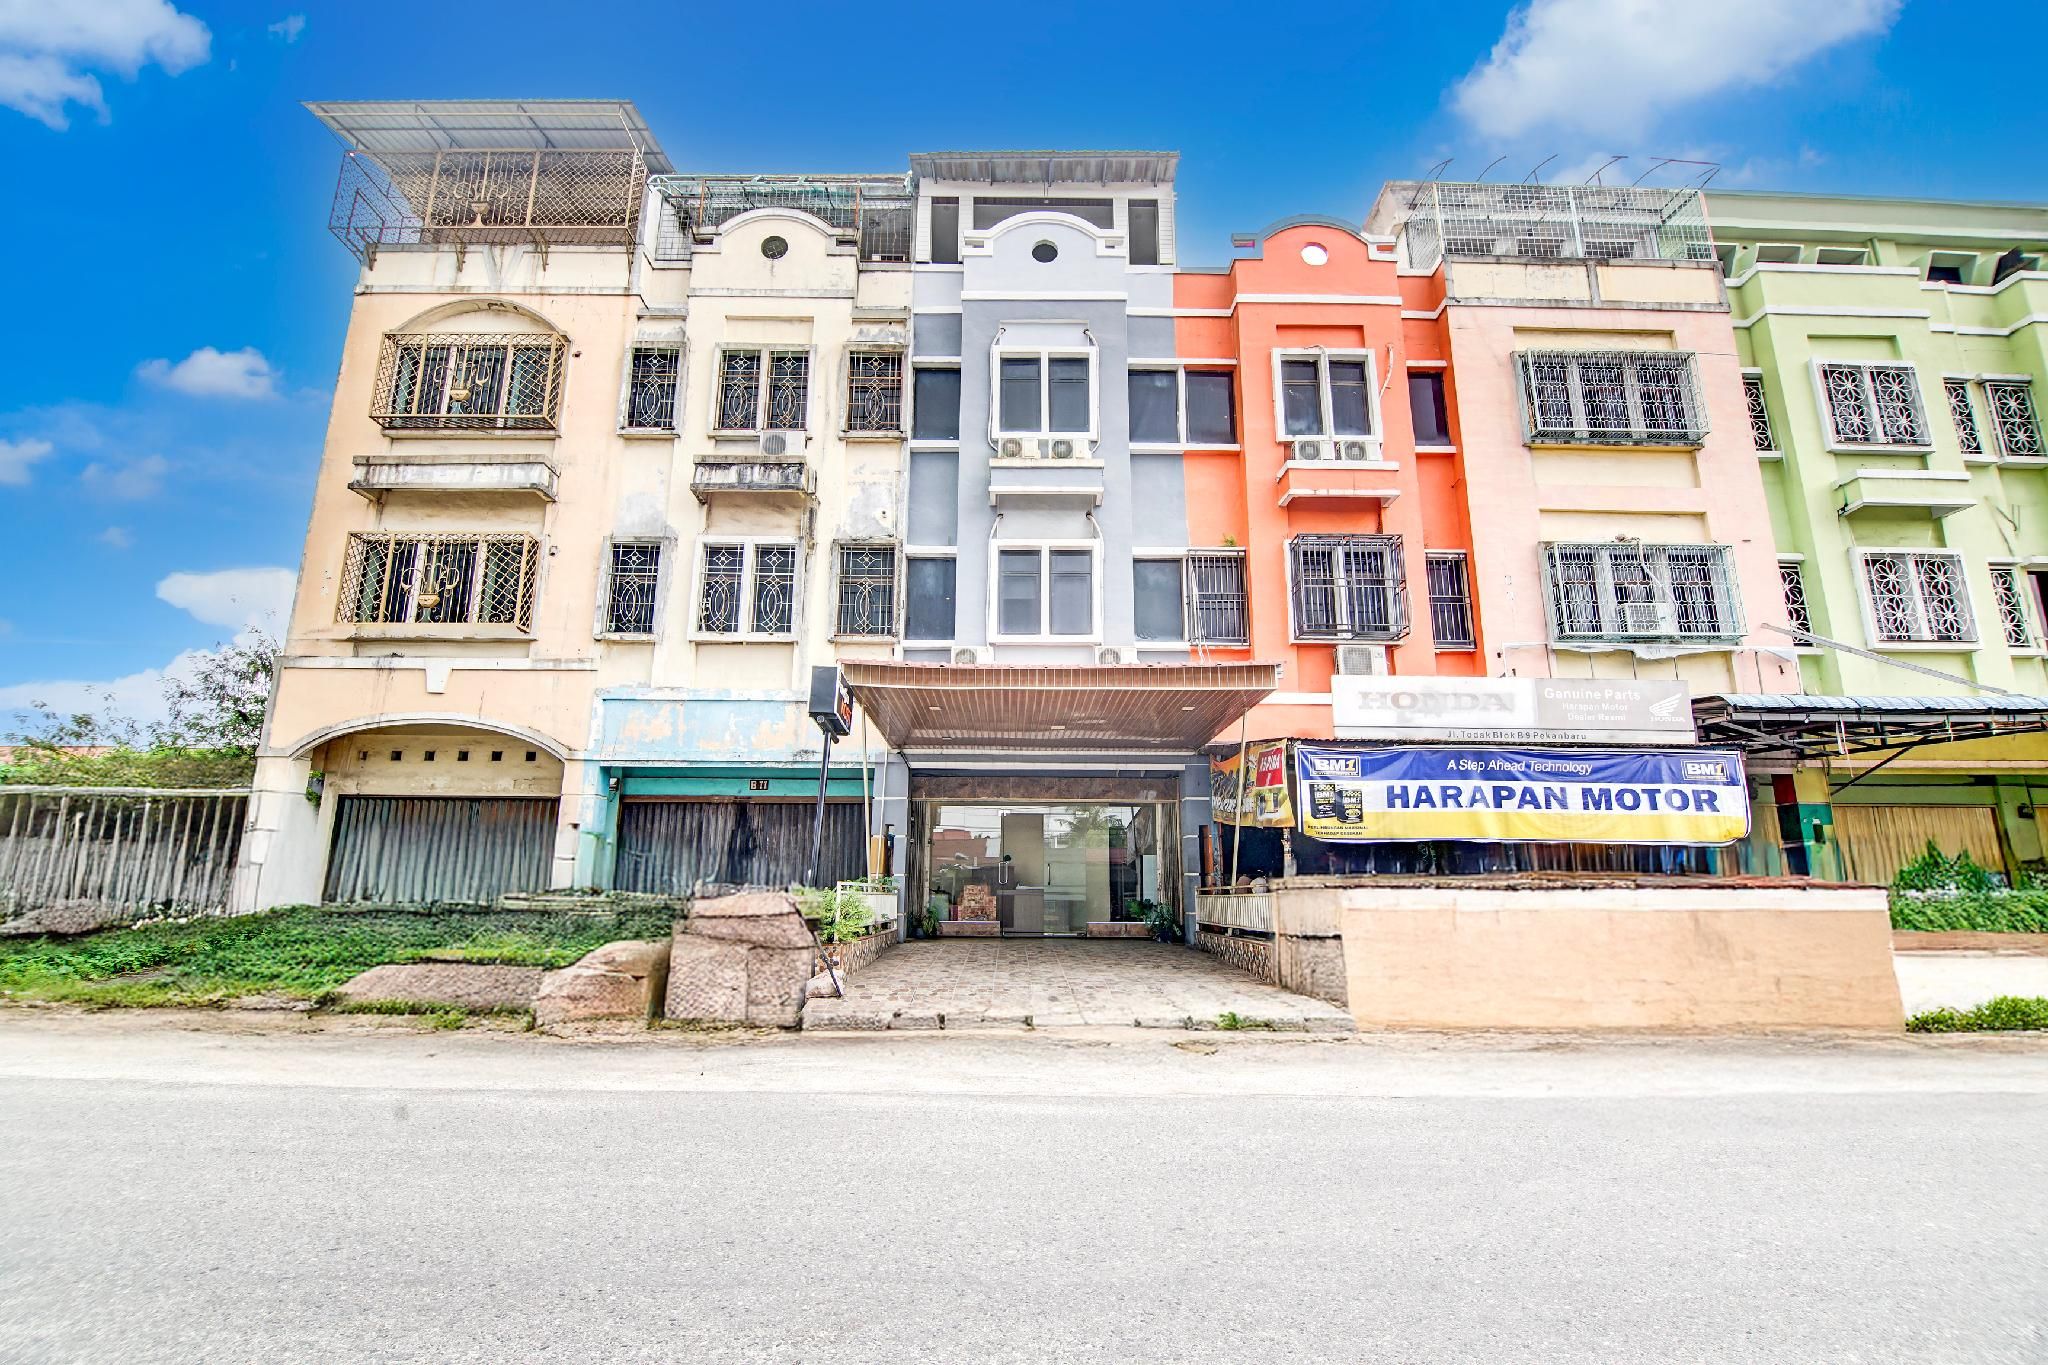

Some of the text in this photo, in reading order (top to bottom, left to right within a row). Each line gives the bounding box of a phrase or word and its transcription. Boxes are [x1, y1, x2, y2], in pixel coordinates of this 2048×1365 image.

[1544, 687, 1641, 701] Genuine Parts
[1358, 691, 1515, 712] HONDA
[1601, 702, 1628, 711] Motor
[1313, 759, 1356, 771] BM1
[1446, 759, 1593, 775] A Step Ahead Technology
[1686, 763, 1724, 776] BM1
[1386, 785, 1721, 812] HARAPAN MOTOR
